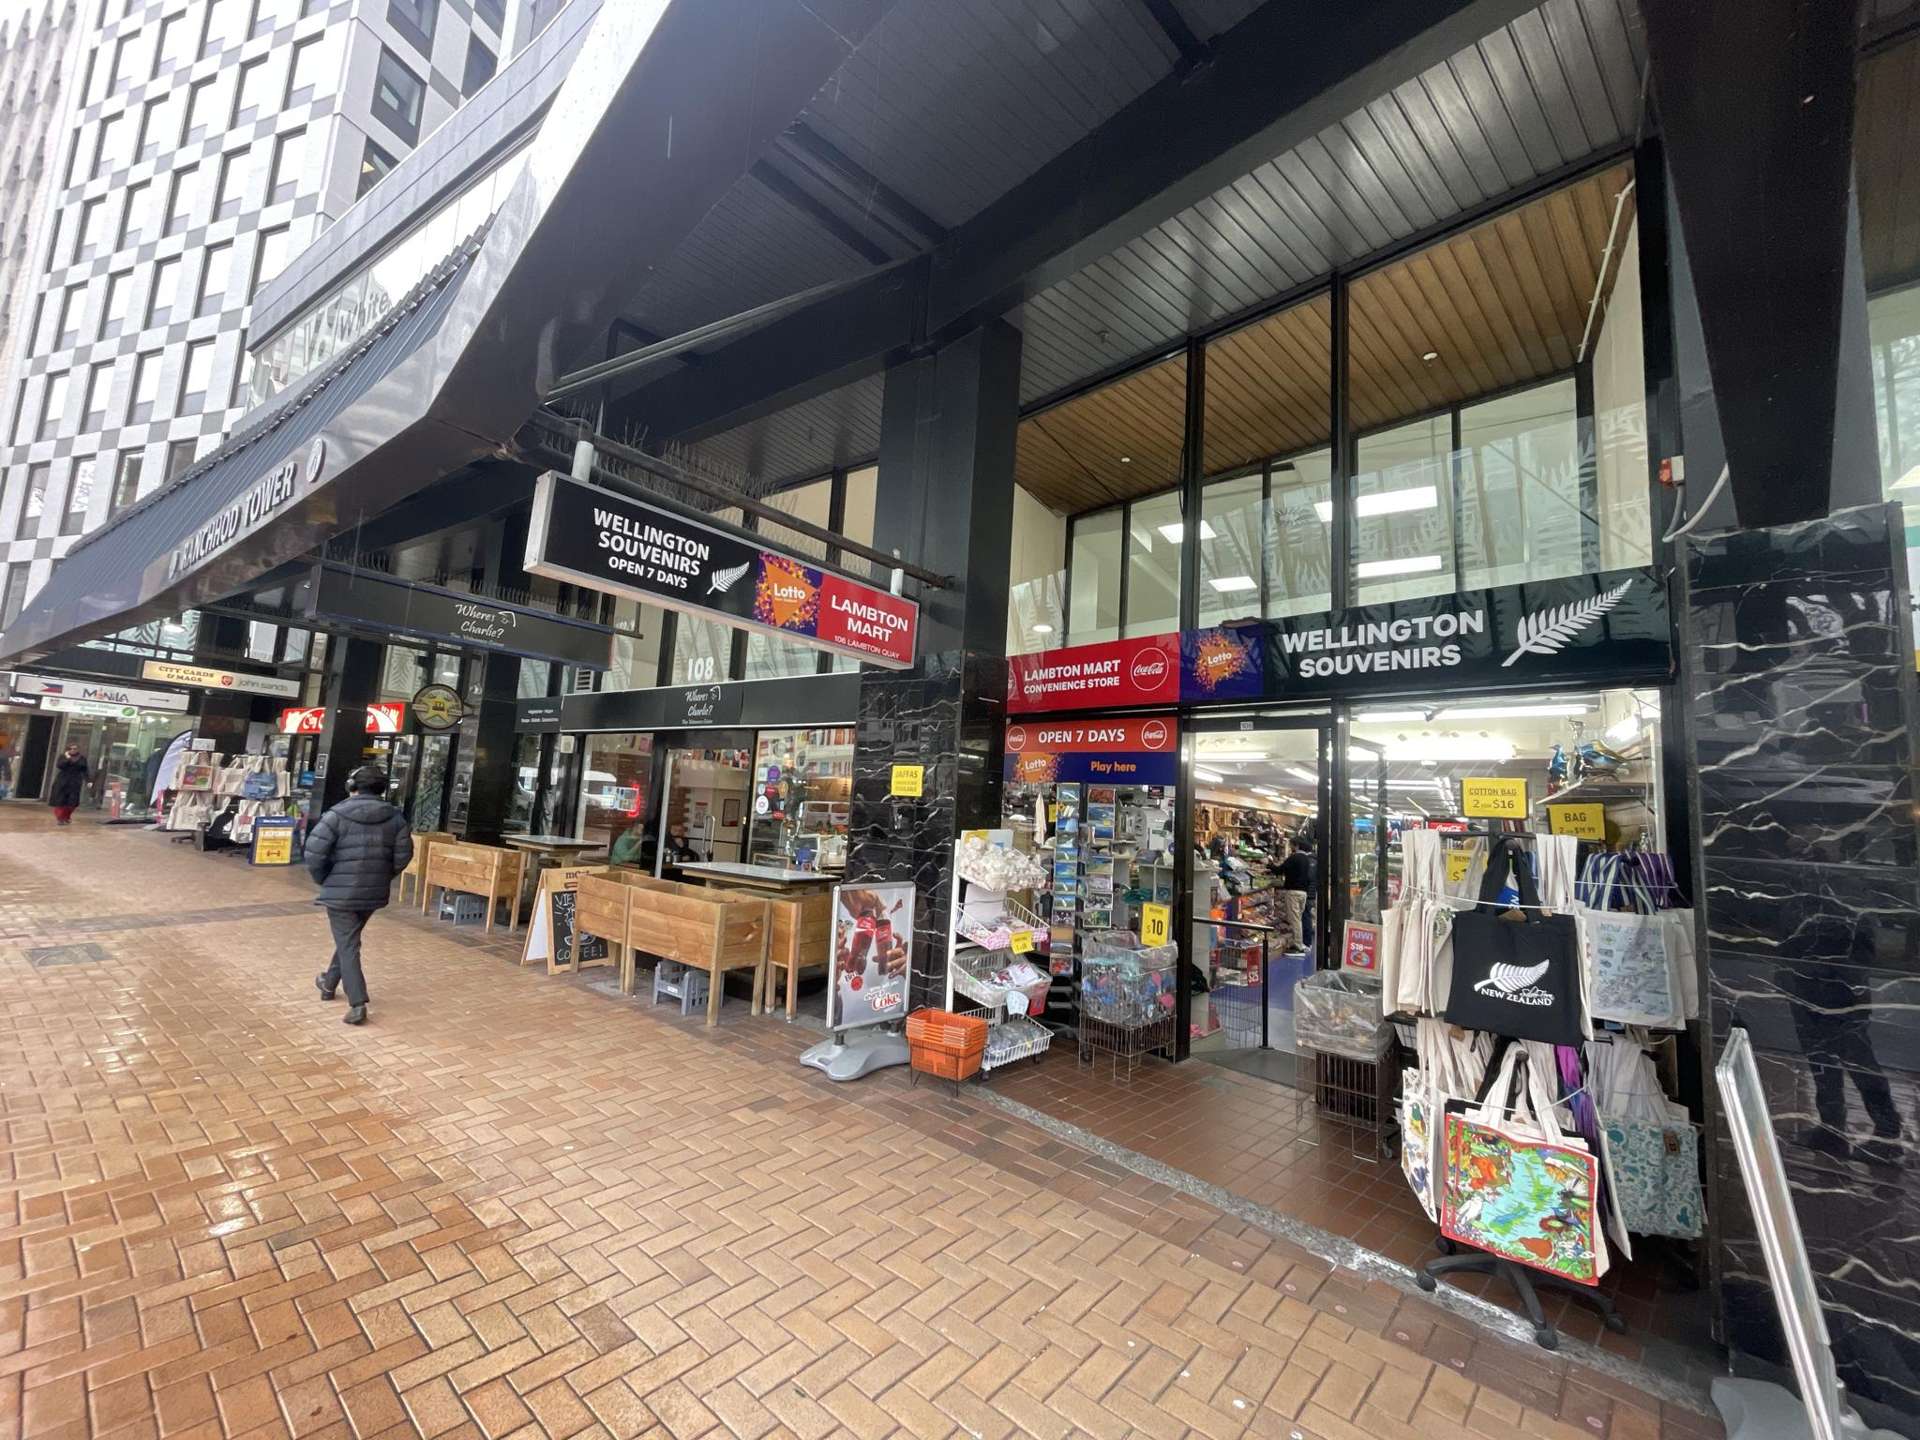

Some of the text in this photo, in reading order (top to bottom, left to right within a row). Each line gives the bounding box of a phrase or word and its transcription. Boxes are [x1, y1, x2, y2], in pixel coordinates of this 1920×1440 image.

[182, 461, 297, 570] RANCHHOD TOWER
[593, 507, 710, 561] WELLINGTON
[598, 531, 701, 576] SOUVENIRS
[608, 556, 688, 589] OPEN 7 DAYS
[774, 583, 806, 600] Lotto
[831, 595, 909, 632] LAMBTON
[461, 620, 505, 639] Charlie?
[847, 618, 893, 642] MART
[1282, 609, 1485, 655] WELLINGTON
[847, 637, 881, 655] LAMBTON
[882, 648, 901, 660] QUAY
[1207, 652, 1232, 665] Lotto
[1299, 644, 1462, 679] SOUVENIRS
[158, 665, 215, 678] CITY CARDS
[688, 656, 714, 681] 108
[1024, 659, 1121, 682] LAMBTON MART
[176, 674, 203, 683] MAGS
[238, 677, 260, 689] john
[1023, 679, 1086, 694] CONVENIENCE
[1087, 676, 1120, 688] STORE
[1038, 729, 1126, 744] OPEN 7 DAYS
[1025, 758, 1047, 770] Lotto
[1090, 761, 1137, 774] Play here
[1469, 787, 1518, 797] COTTON BAG
[1472, 799, 1480, 809] 2
[1493, 799, 1515, 809] $16
[1564, 812, 1587, 823] BAG
[1146, 918, 1164, 937] $10
[556, 944, 603, 961] COEE!
[1480, 988, 1552, 1006] NEW ZEALAND
